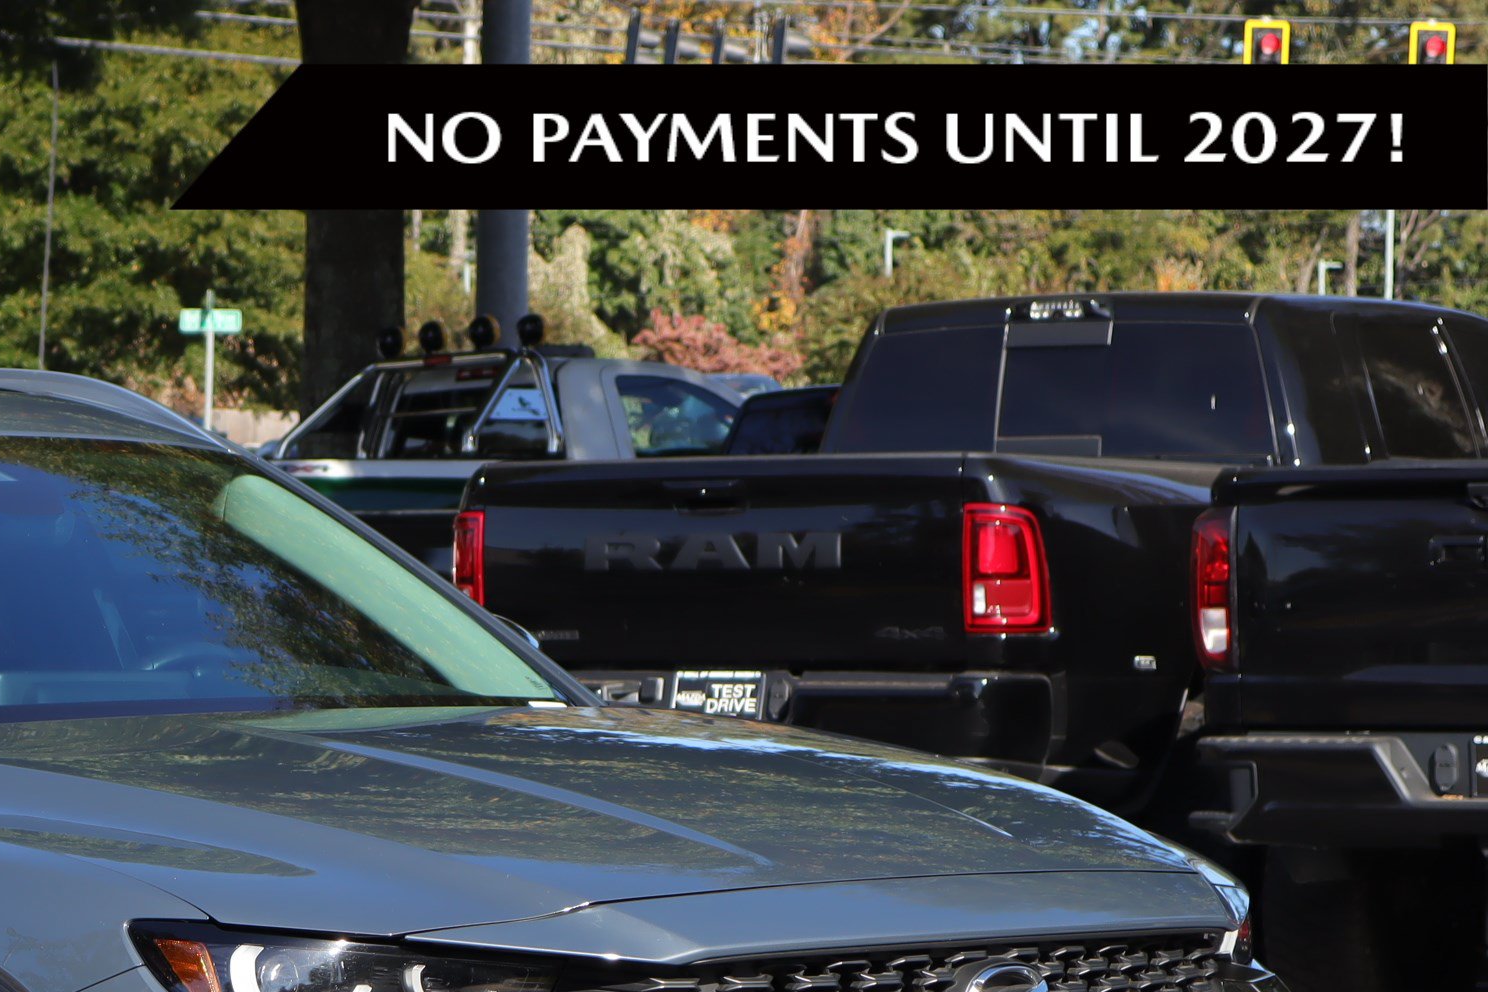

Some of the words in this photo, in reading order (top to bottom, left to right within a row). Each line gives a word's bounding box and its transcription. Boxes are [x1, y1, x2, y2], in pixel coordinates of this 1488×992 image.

[585, 532, 842, 570] RAM
[712, 683, 755, 699] TEST
[706, 698, 756, 713] DRIVE
